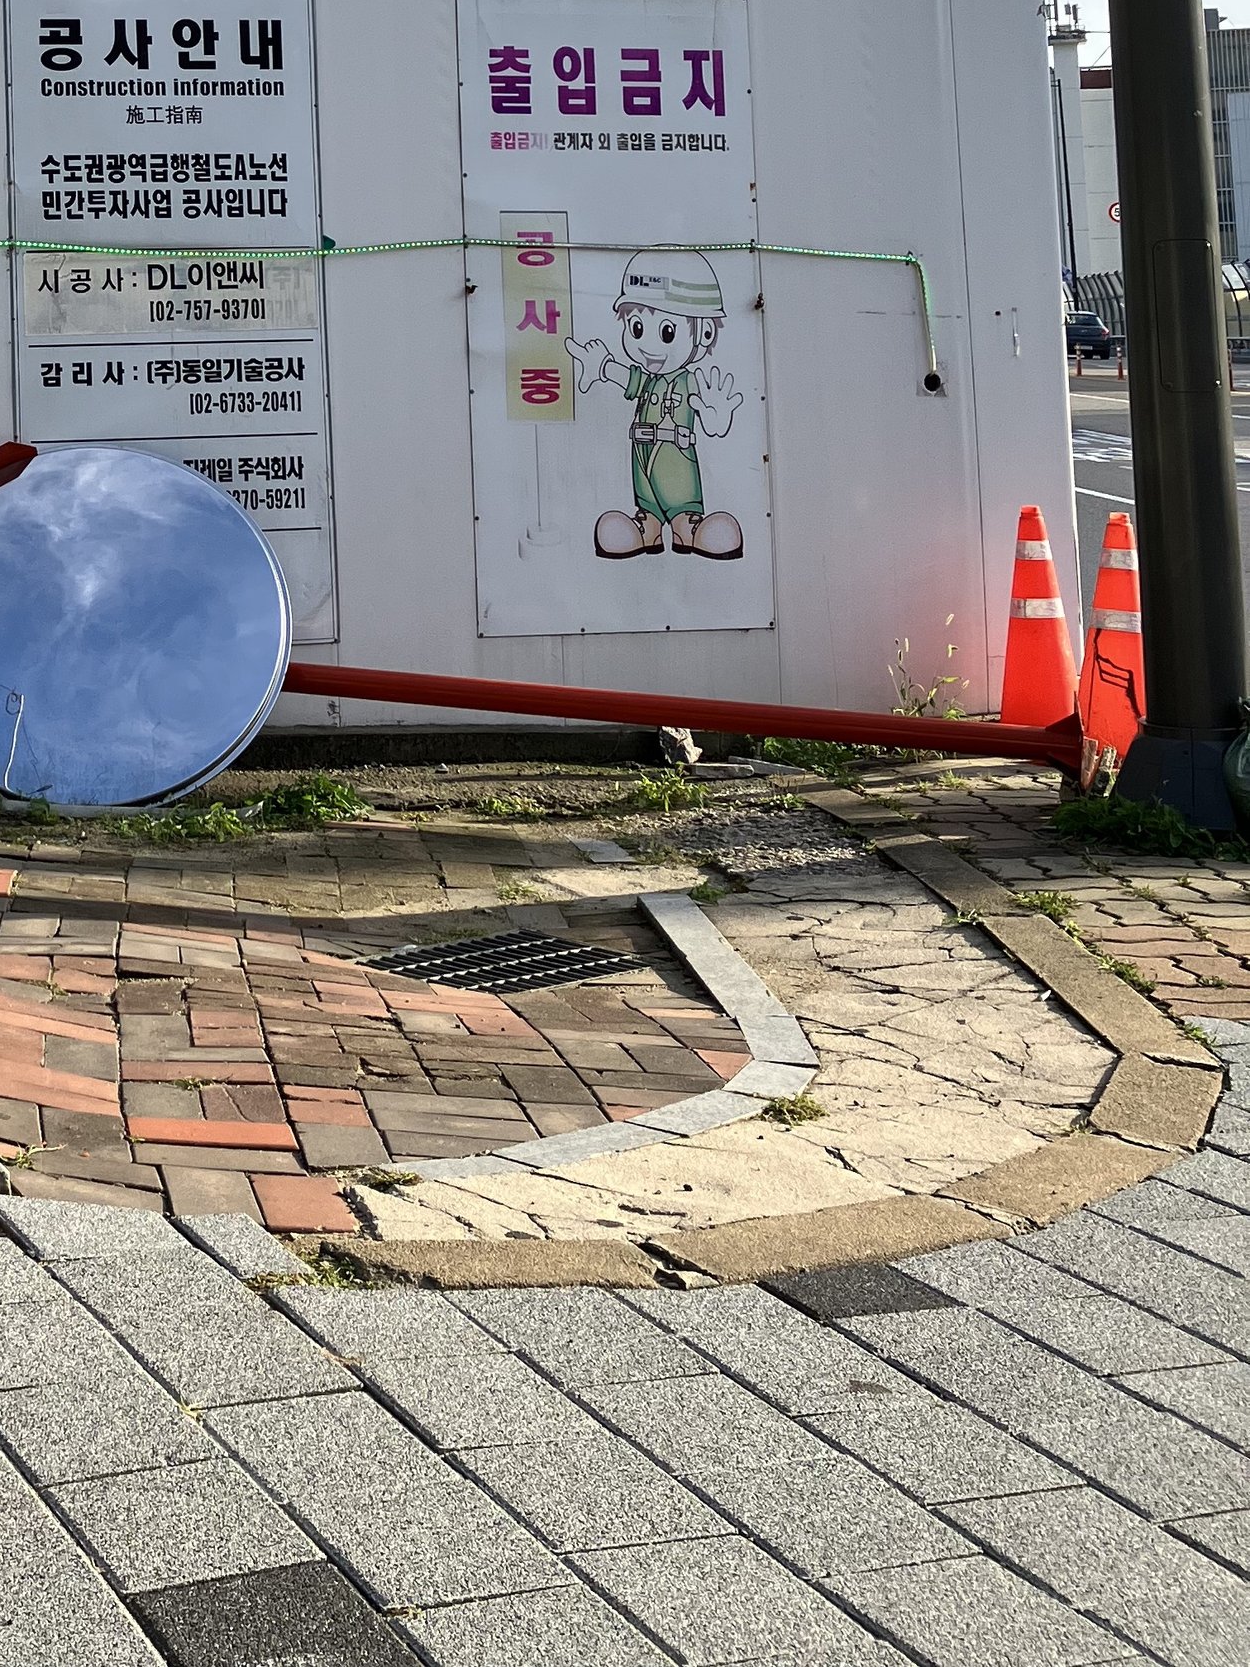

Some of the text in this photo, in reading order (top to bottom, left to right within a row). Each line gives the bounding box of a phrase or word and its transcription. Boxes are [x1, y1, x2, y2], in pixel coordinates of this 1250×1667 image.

[40, 78, 285, 97] Construction information
[487, 46, 726, 117] 출입금지
[125, 105, 204, 125] 施工指南
[553, 132, 594, 151] 관계자
[597, 132, 611, 151] 외
[616, 132, 656, 152] 출입을
[661, 133, 730, 152] 금지합니다.
[40, 153, 289, 184] 수도권광역급행철도A노선
[41, 188, 288, 220] 민간투자사업 공사입니다
[147, 260, 265, 291] DL이앤씨
[238, 455, 304, 482] 주식회사
